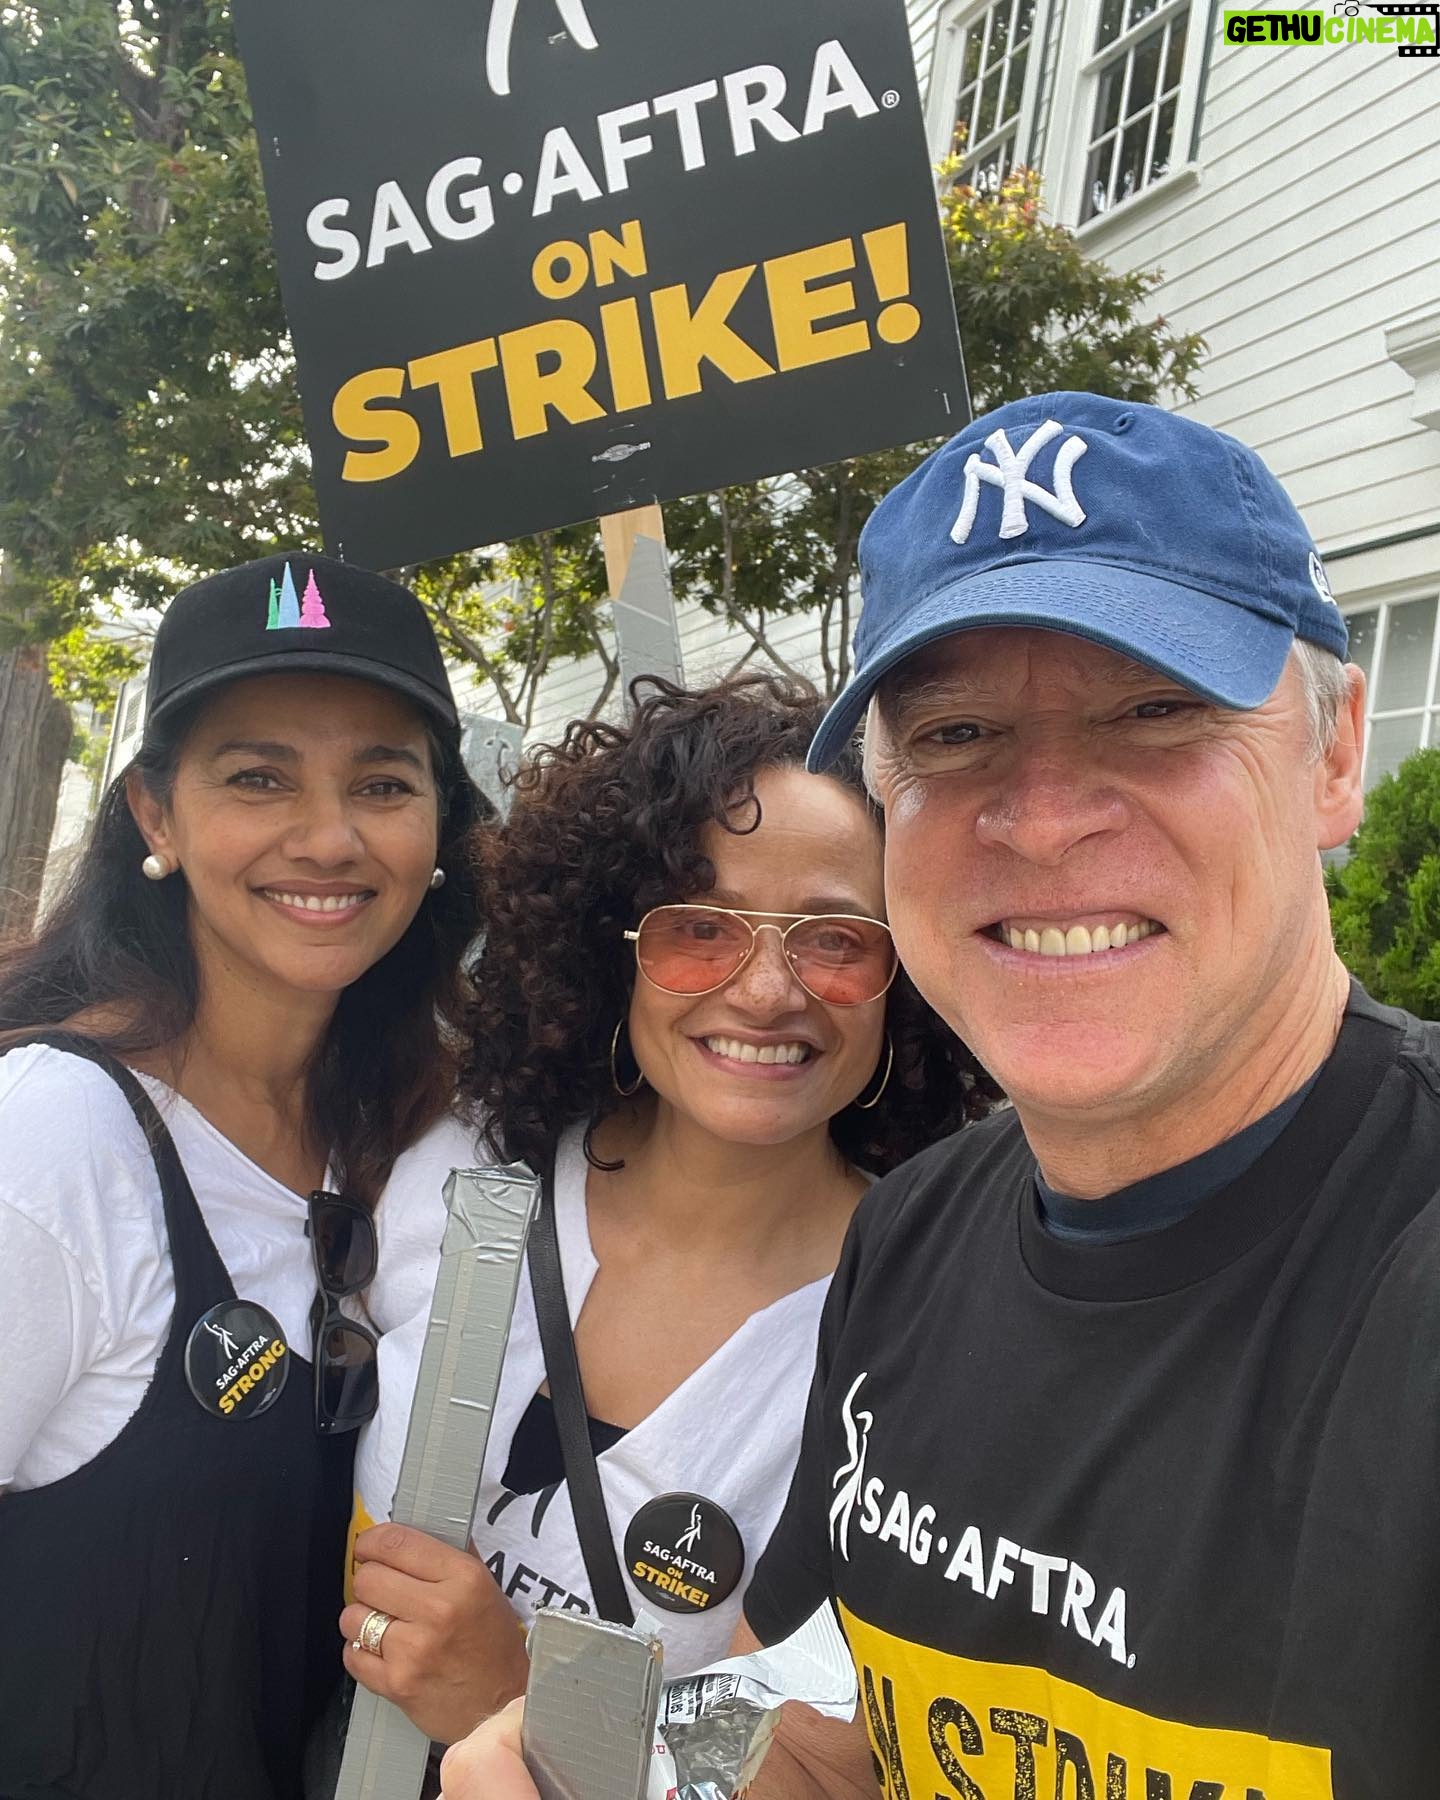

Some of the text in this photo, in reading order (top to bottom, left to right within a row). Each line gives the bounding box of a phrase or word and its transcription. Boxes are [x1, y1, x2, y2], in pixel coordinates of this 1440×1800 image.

[531, 219, 649, 300] ON
[331, 222, 922, 482] STRIKE!
[218, 1339, 286, 1414] STRONG
[632, 1561, 710, 1607] STRIKE!
[666, 1566, 684, 1579] ON
